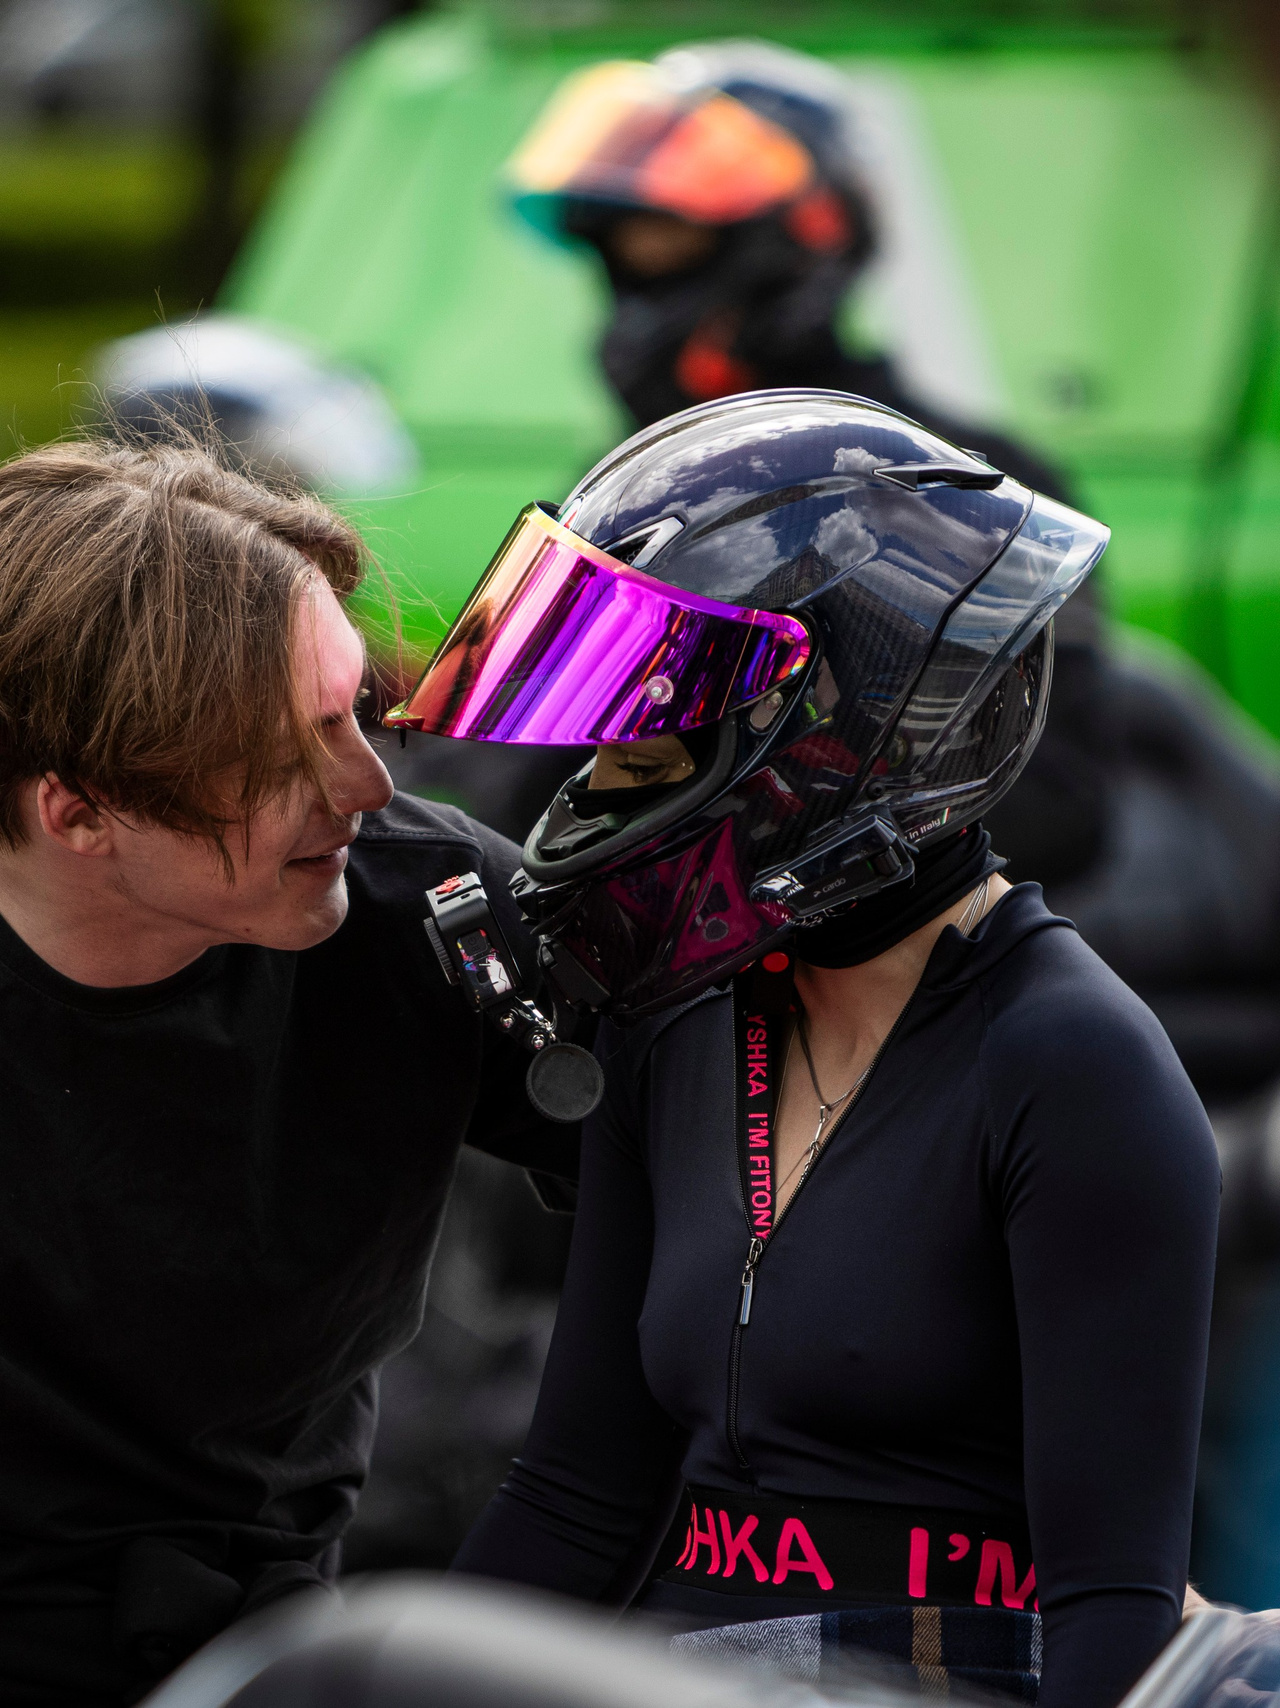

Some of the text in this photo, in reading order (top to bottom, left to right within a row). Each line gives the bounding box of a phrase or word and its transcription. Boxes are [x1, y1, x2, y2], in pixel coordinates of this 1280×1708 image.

[920, 818, 941, 834] Italy
[822, 877, 846, 893] cardo
[748, 1113, 769, 1148] I'M
[675, 1503, 834, 1591] HKA
